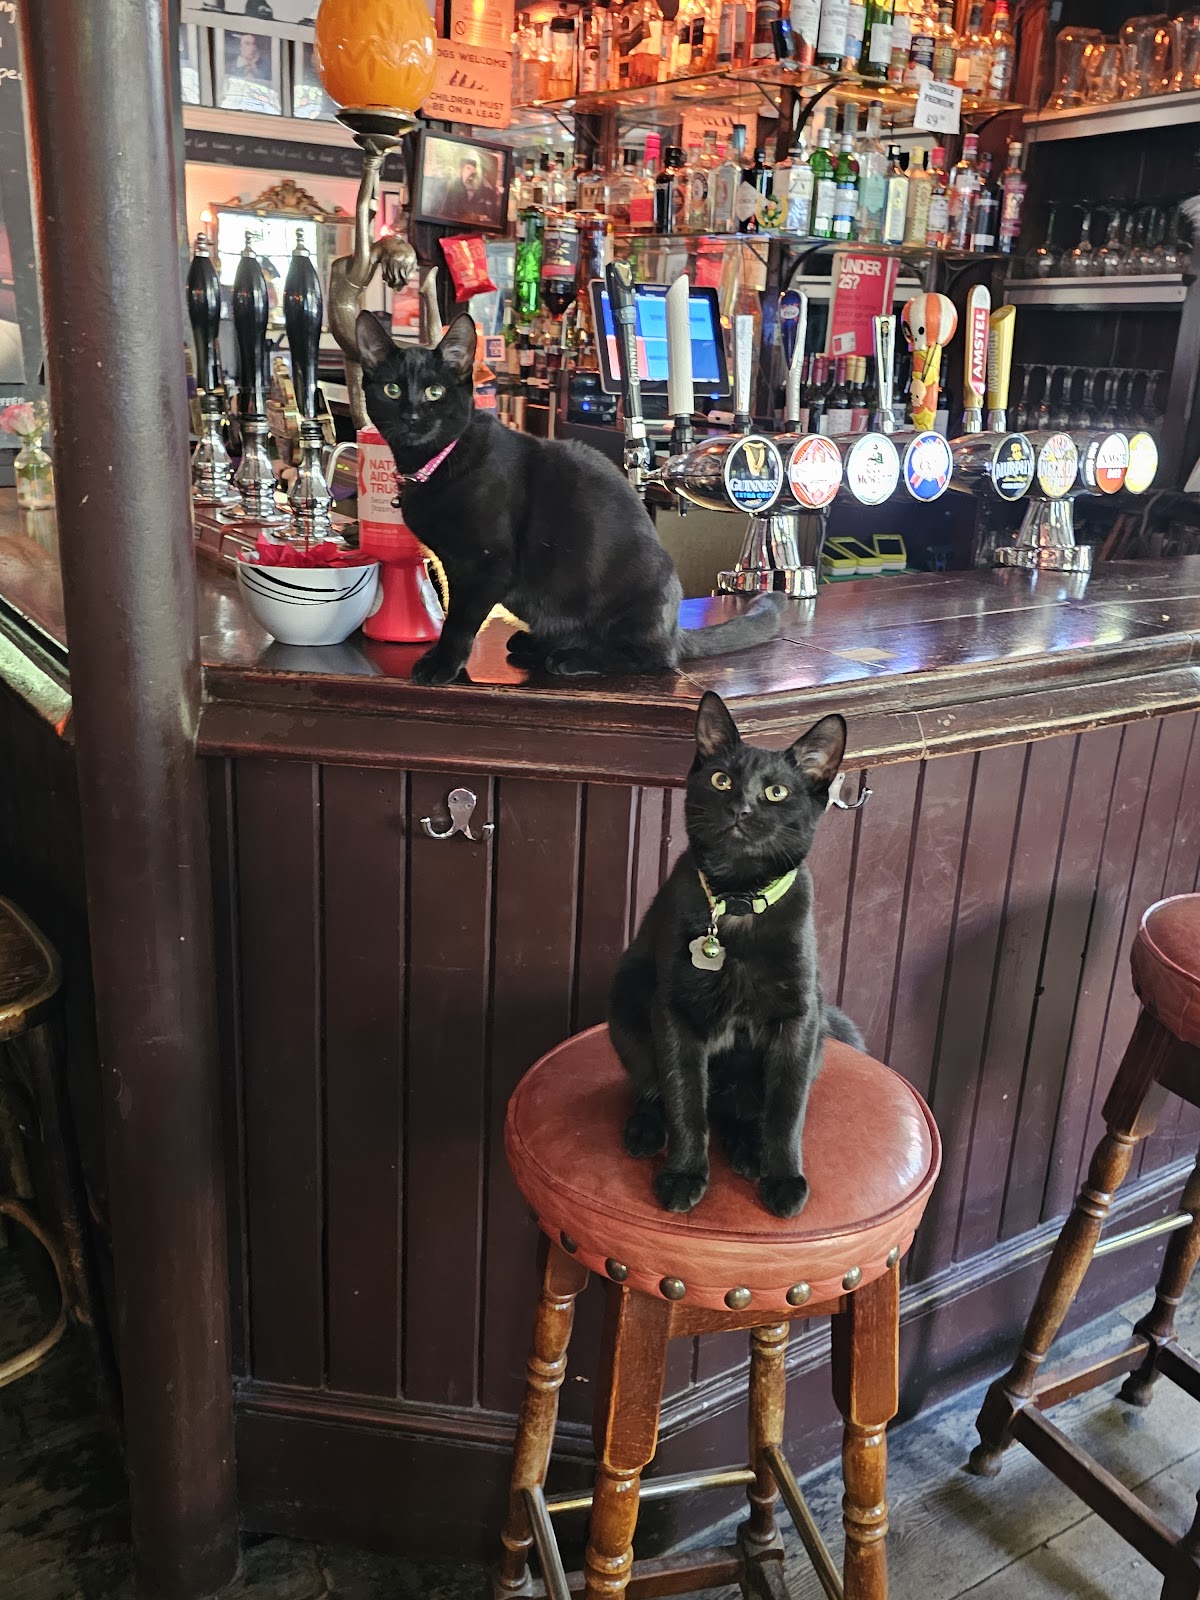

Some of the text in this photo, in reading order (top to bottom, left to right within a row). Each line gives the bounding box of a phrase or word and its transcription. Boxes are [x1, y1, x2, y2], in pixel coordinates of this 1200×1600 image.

[437, 48, 507, 68] OGS WELCOME
[429, 92, 504, 110] CHILDREN MUST
[432, 102, 444, 111] BE
[449, 105, 462, 113] ON
[476, 110, 501, 119] LEAD
[841, 258, 882, 276] UNDER
[838, 274, 861, 289] 25?
[972, 310, 986, 379] AMSTEL
[629, 334, 640, 386] GUINNESS
[370, 483, 399, 494] TRUS
[729, 478, 778, 492] GUINNESS
